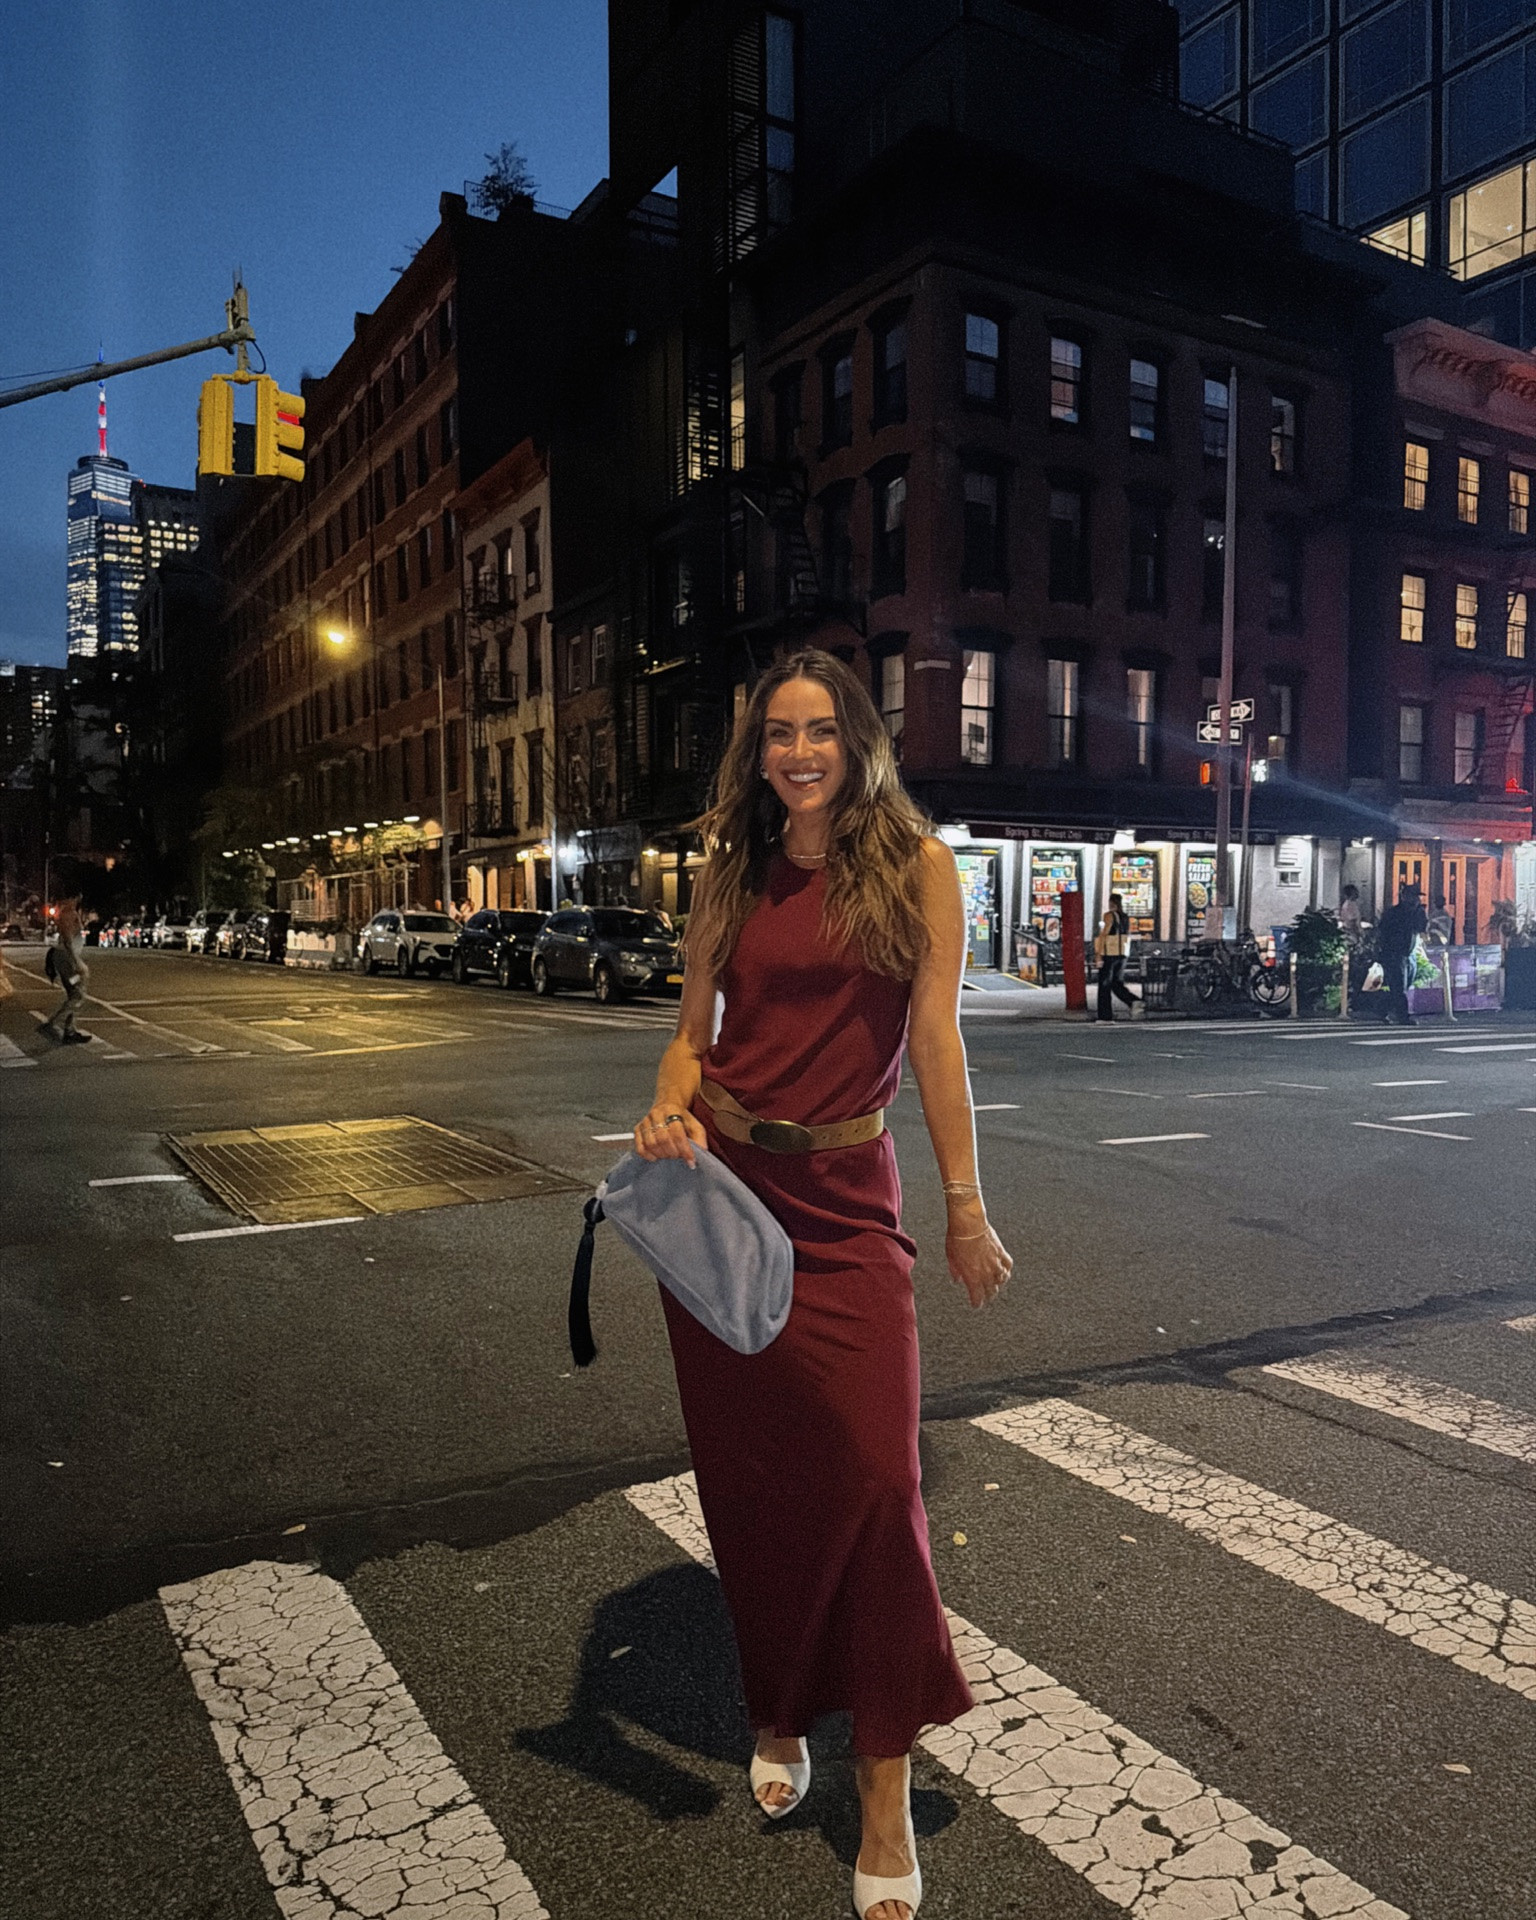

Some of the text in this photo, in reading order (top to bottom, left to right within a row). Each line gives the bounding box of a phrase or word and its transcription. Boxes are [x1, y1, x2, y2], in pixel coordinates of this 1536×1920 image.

[1233, 707, 1247, 716] WAY
[1204, 728, 1217, 737] ONE
[1005, 826, 1029, 839] Spring
[1167, 829, 1190, 841] Spring
[1188, 863, 1211, 873] FRESH
[1188, 872, 1211, 882] SALAD
